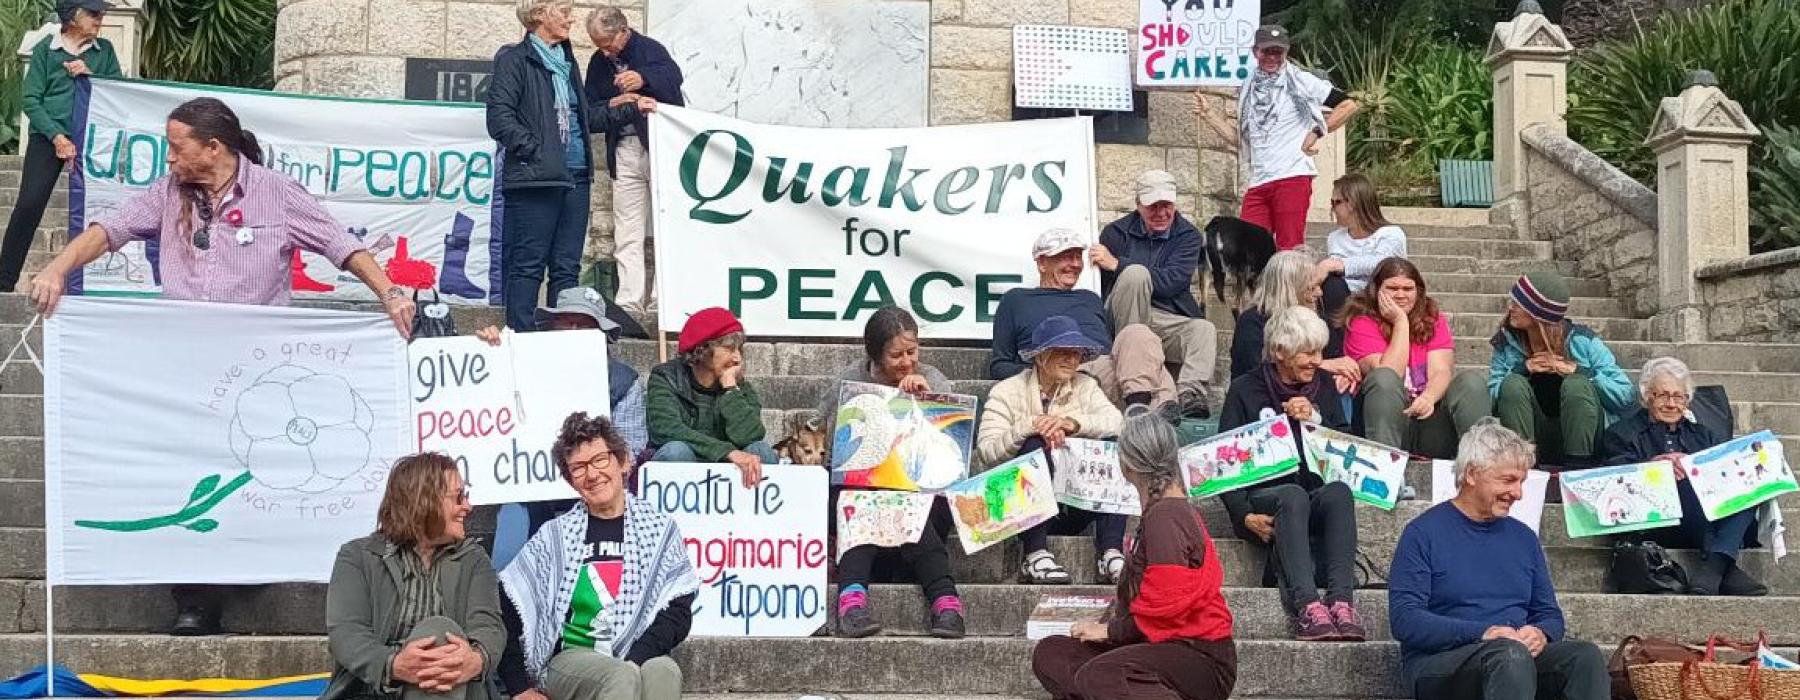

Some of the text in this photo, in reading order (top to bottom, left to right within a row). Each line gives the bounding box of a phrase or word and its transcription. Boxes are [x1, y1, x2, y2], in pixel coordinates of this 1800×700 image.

[1142, 20, 1254, 51] SHOULD
[1162, 0, 1234, 22] YOU
[1145, 47, 1250, 80] CARE!
[330, 148, 493, 205] Peace
[679, 129, 1066, 224] Quakers
[842, 217, 911, 256] for
[728, 267, 1024, 323] PEACE
[201, 341, 353, 412] have a great
[415, 349, 491, 403] give
[417, 406, 516, 454] peace
[242, 456, 392, 519] war free day
[643, 467, 735, 515] hoatū
[711, 570, 826, 636] tūpono.
